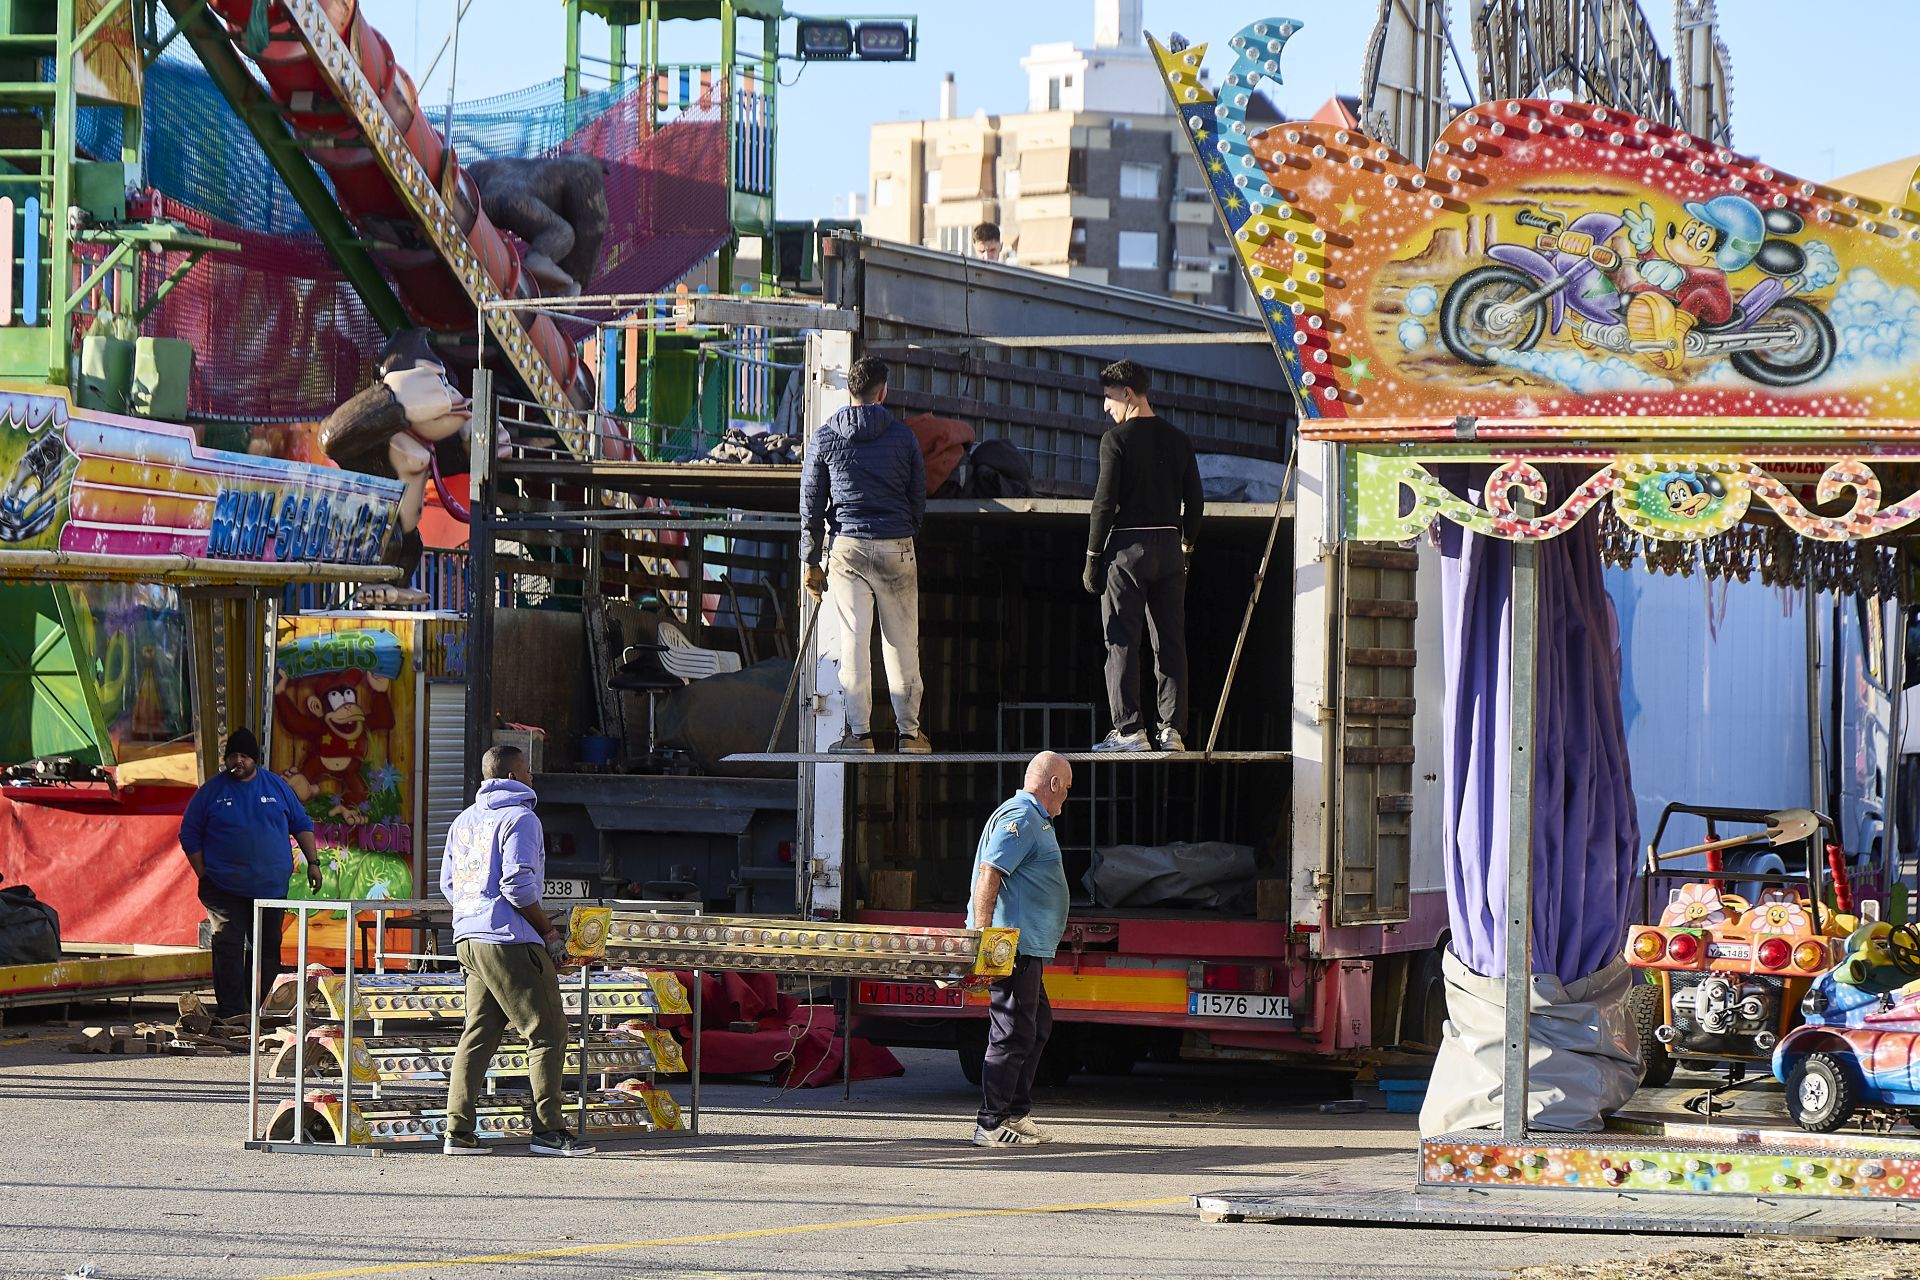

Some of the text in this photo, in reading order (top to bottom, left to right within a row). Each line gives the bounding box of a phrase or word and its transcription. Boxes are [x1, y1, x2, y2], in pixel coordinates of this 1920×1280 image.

[1727, 950, 1749, 958] 1485
[869, 985, 957, 1005] V 11583 R
[1202, 995, 1248, 1015] 1576
